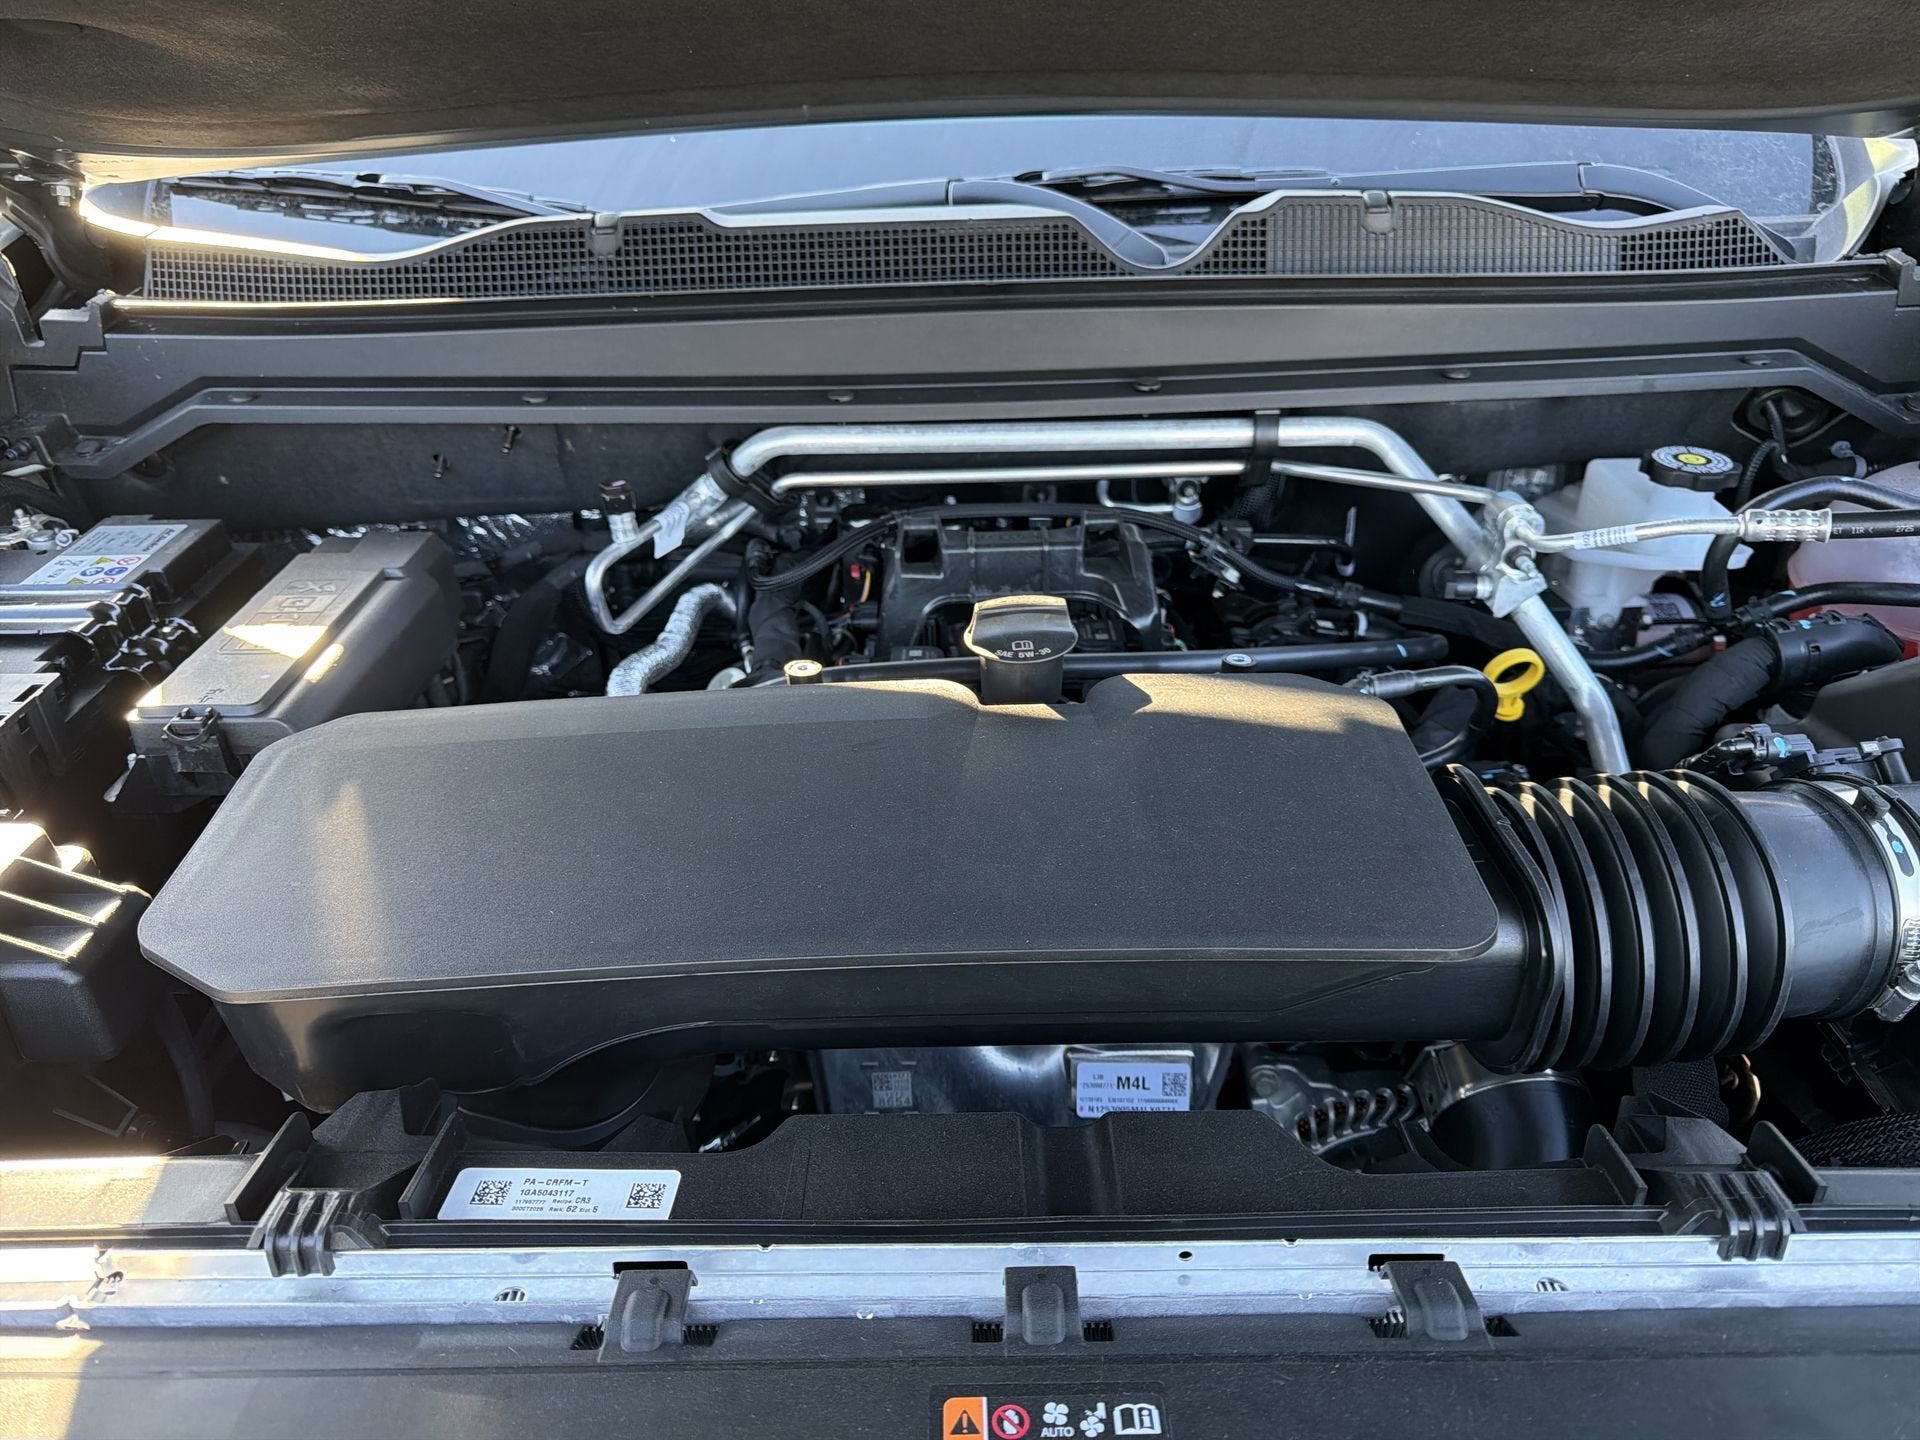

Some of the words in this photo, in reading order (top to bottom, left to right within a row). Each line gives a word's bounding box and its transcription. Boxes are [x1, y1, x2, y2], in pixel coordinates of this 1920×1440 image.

[995, 650, 1014, 658] SAE
[1018, 647, 1051, 658] 5W-30
[1116, 1076, 1151, 1090] M4L
[520, 1189, 575, 1197] 1GA5043117
[592, 1205, 599, 1213] 5
[1040, 1426, 1075, 1438] AUTO
